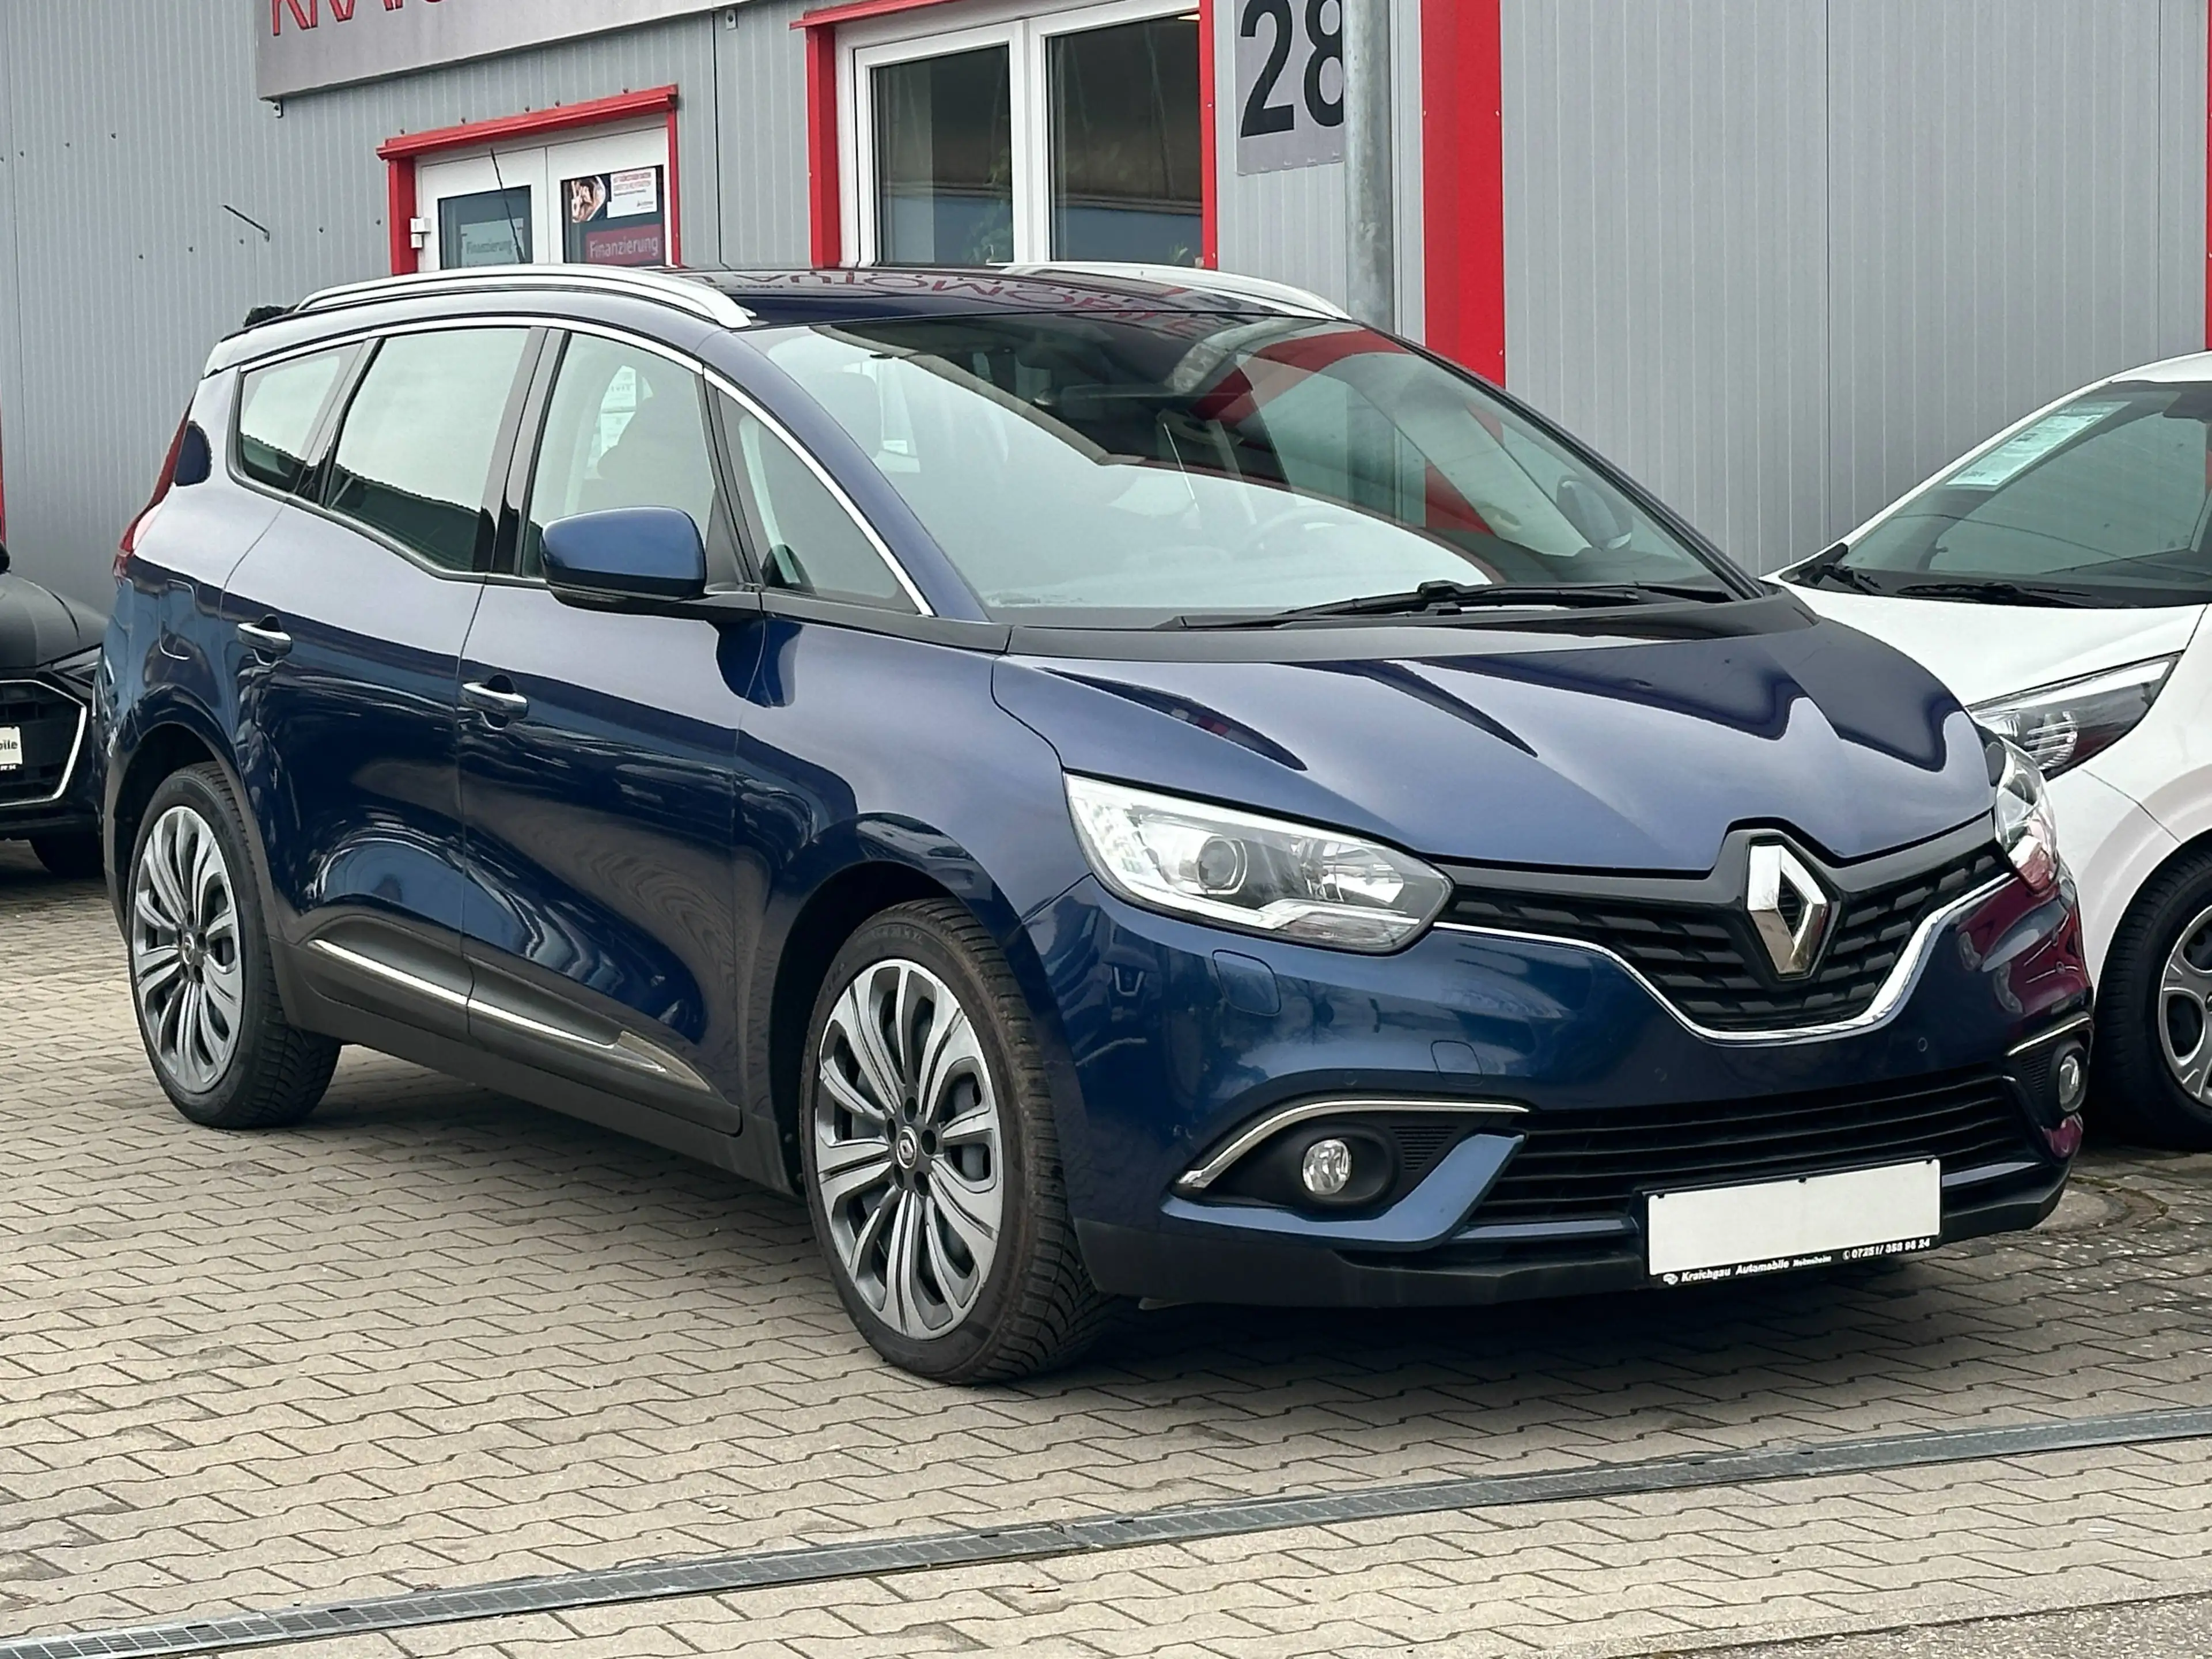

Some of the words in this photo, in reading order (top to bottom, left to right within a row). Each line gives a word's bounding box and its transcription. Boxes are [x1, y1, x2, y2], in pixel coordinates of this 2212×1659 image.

[1241, 0, 1344, 138] 28
[589, 235, 658, 259] Finanzierung
[1681, 1267, 1731, 1282] Kraichgau
[1735, 1258, 1790, 1275] Automobile
